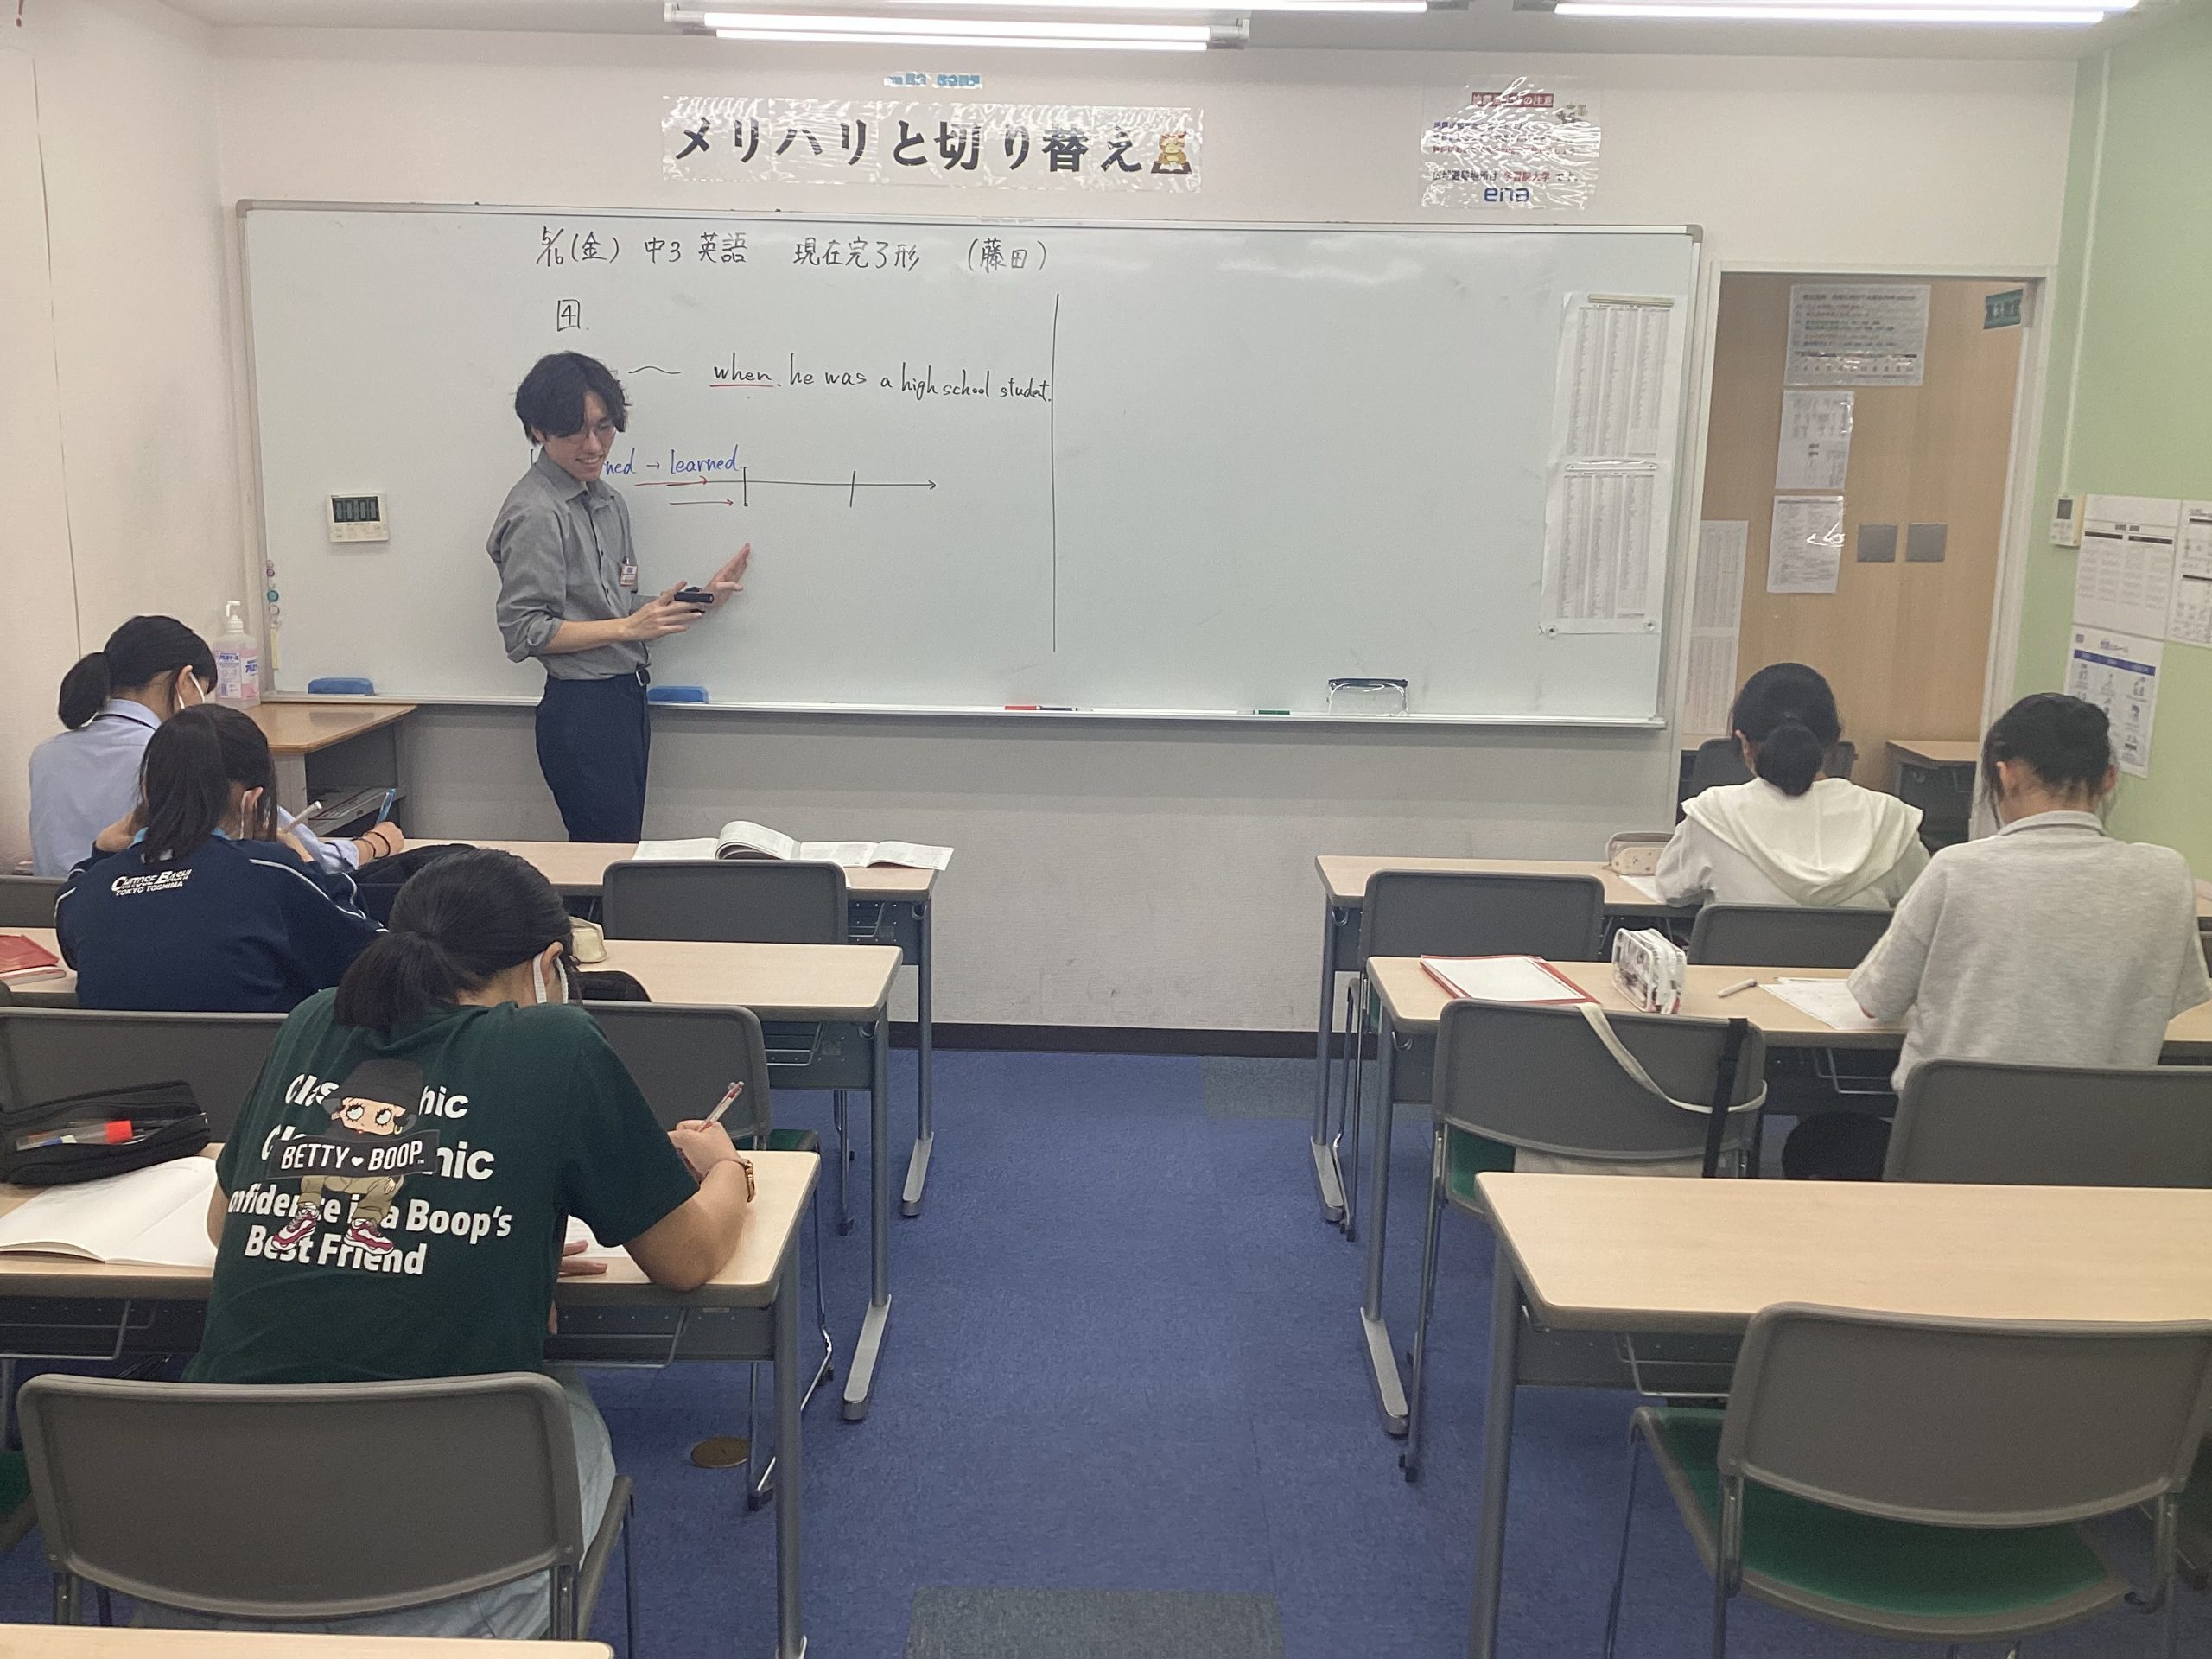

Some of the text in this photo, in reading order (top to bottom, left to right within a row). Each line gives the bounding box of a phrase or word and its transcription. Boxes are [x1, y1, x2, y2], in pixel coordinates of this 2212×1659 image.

[676, 116, 1143, 174] メリハリと切り替え
[698, 231, 747, 263] 英語
[792, 235, 920, 271] 現在完了形
[968, 238, 1047, 274] (藤田)
[790, 352, 815, 385] he
[824, 371, 867, 386] was
[880, 376, 893, 389] a
[902, 361, 939, 401] high
[942, 369, 990, 398] school
[671, 444, 739, 474] learned
[115, 886, 144, 897] TOKYO
[281, 1142, 350, 1170] BETTY
[368, 1140, 423, 1171] BOOP
[380, 1204, 400, 1230] a
[405, 1198, 512, 1245] Boop's
